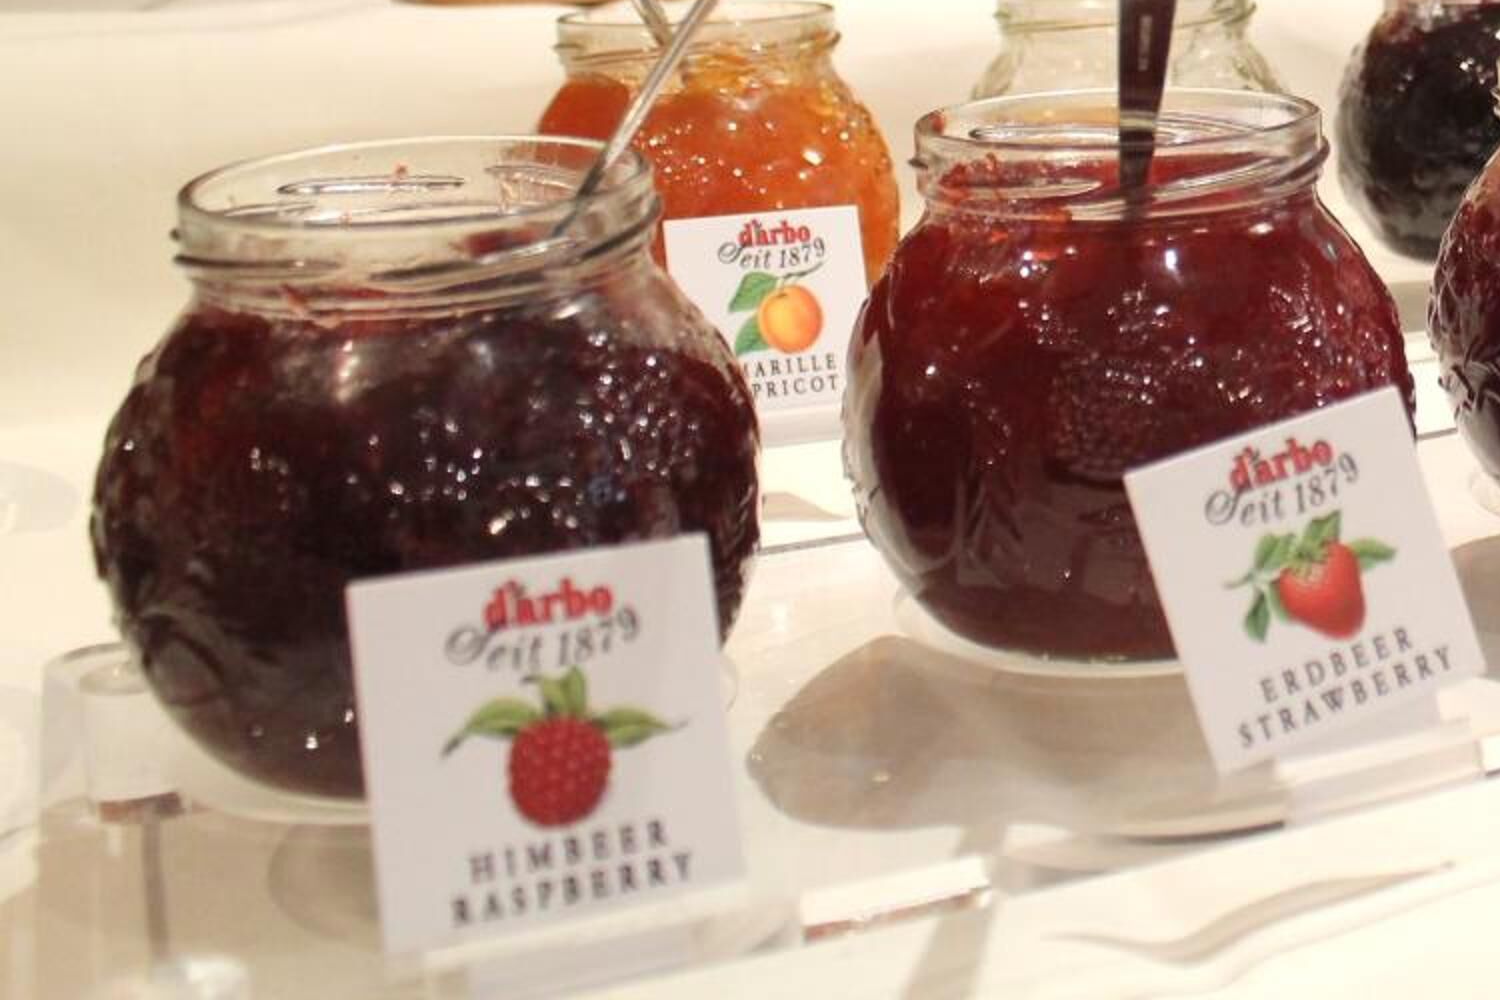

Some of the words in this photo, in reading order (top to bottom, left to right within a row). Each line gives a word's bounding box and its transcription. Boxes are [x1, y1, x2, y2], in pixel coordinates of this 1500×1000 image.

[717, 241, 771, 269] Seit
[779, 237, 826, 269] 1879
[743, 353, 838, 378] ARILLE
[751, 374, 839, 399] PRICOT
[1204, 490, 1286, 528] Seit
[1295, 452, 1359, 516] 1879
[444, 626, 544, 671] Seit
[558, 607, 640, 667] 1879
[1259, 628, 1413, 704] ERDBEER
[1237, 646, 1453, 749] STRAWBERRY
[469, 819, 669, 885] HIMBEER
[451, 852, 693, 927] RASPBERRY
